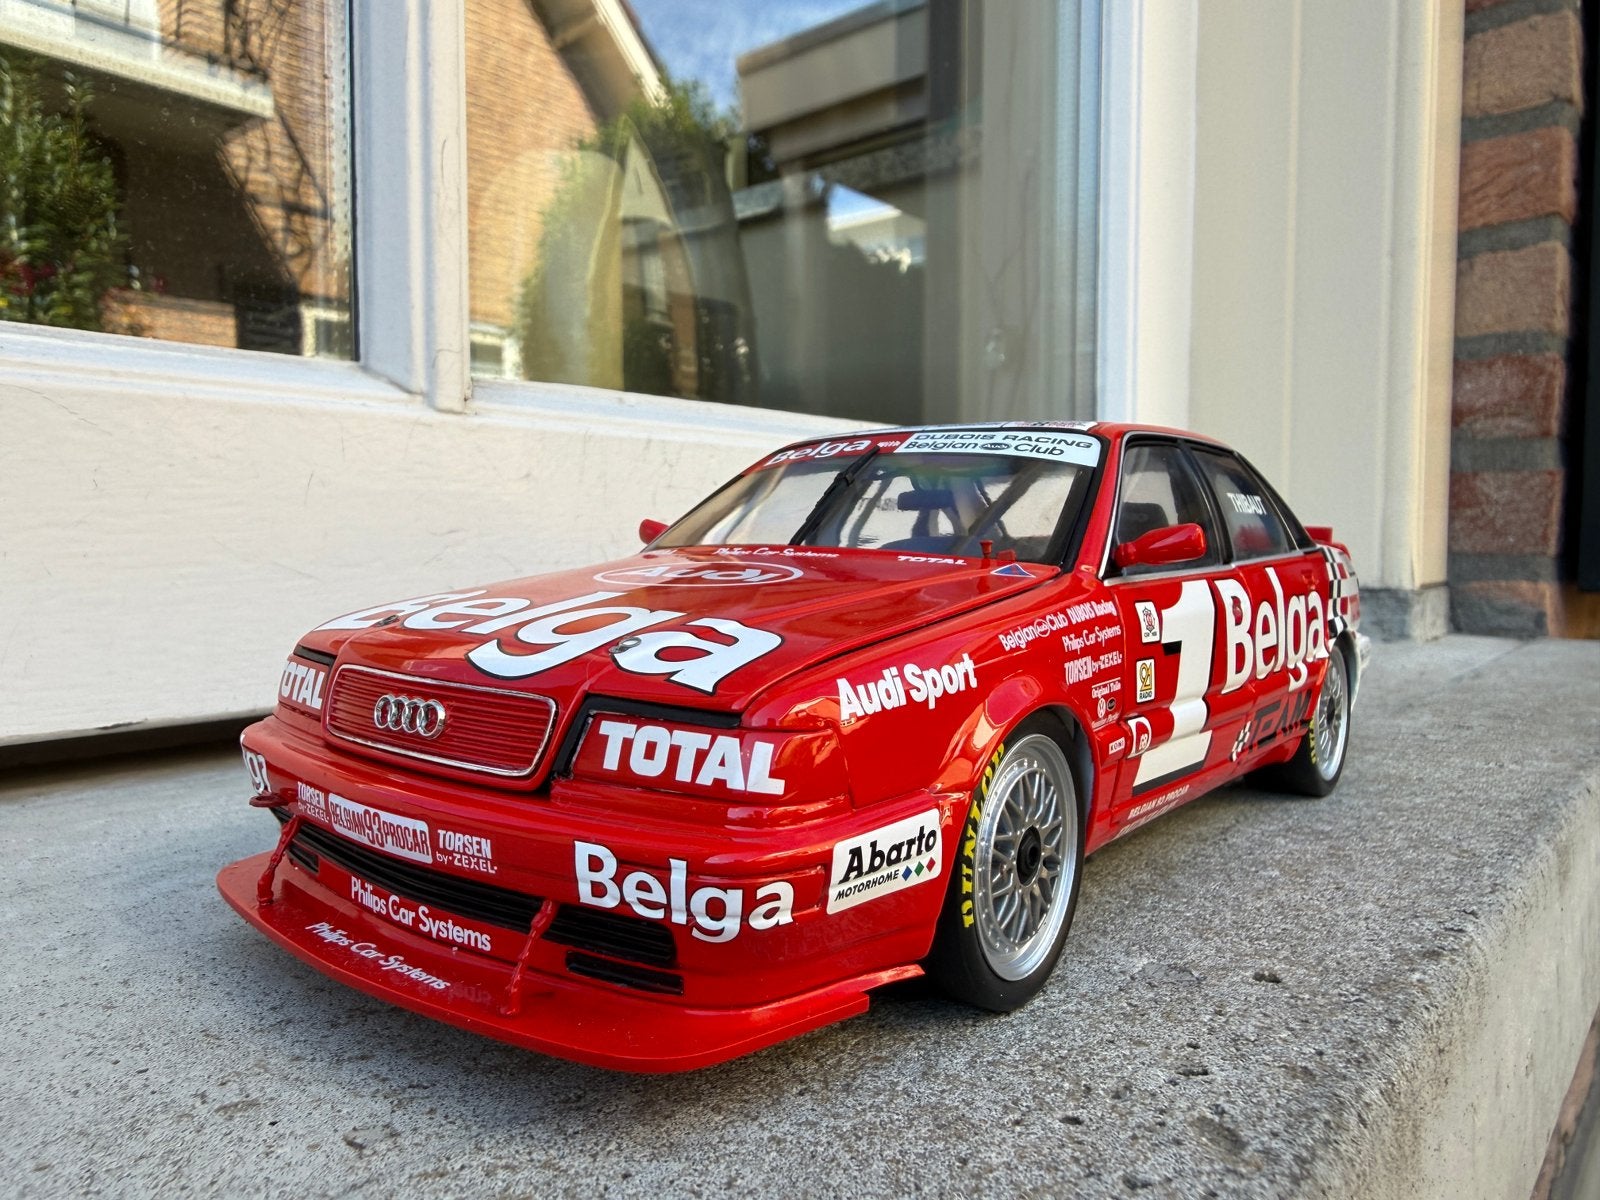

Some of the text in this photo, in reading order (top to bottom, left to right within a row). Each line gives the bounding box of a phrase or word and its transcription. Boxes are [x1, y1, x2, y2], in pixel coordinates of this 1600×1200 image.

[763, 439, 872, 467] Belga
[904, 441, 979, 451] Belgian
[1013, 443, 1065, 456] Club
[914, 433, 1094, 449] DUBOIS RACING
[898, 555, 967, 566] TOTAL
[313, 589, 784, 695] Belga
[998, 625, 1039, 652] Belgian
[1046, 611, 1069, 631] Club
[1062, 625, 1122, 654] Philips Car Systems
[1214, 566, 1330, 695] Belga
[281, 661, 326, 710] OTAL
[836, 653, 978, 721] Audi Sport
[1064, 655, 1093, 686] TORSEN
[1132, 579, 1216, 790] 1
[1139, 691, 1153, 700] RADIO
[598, 719, 786, 796] TOTAL
[1110, 739, 1124, 752] KONI
[297, 781, 326, 810] TORSEN
[438, 829, 493, 860] TORSEN
[838, 824, 938, 884] Abarto
[573, 840, 795, 943] Belga
[834, 868, 900, 902] MOTORHOME
[351, 875, 492, 952] Philips Car Systems
[305, 921, 451, 990] Philips Car Systems
